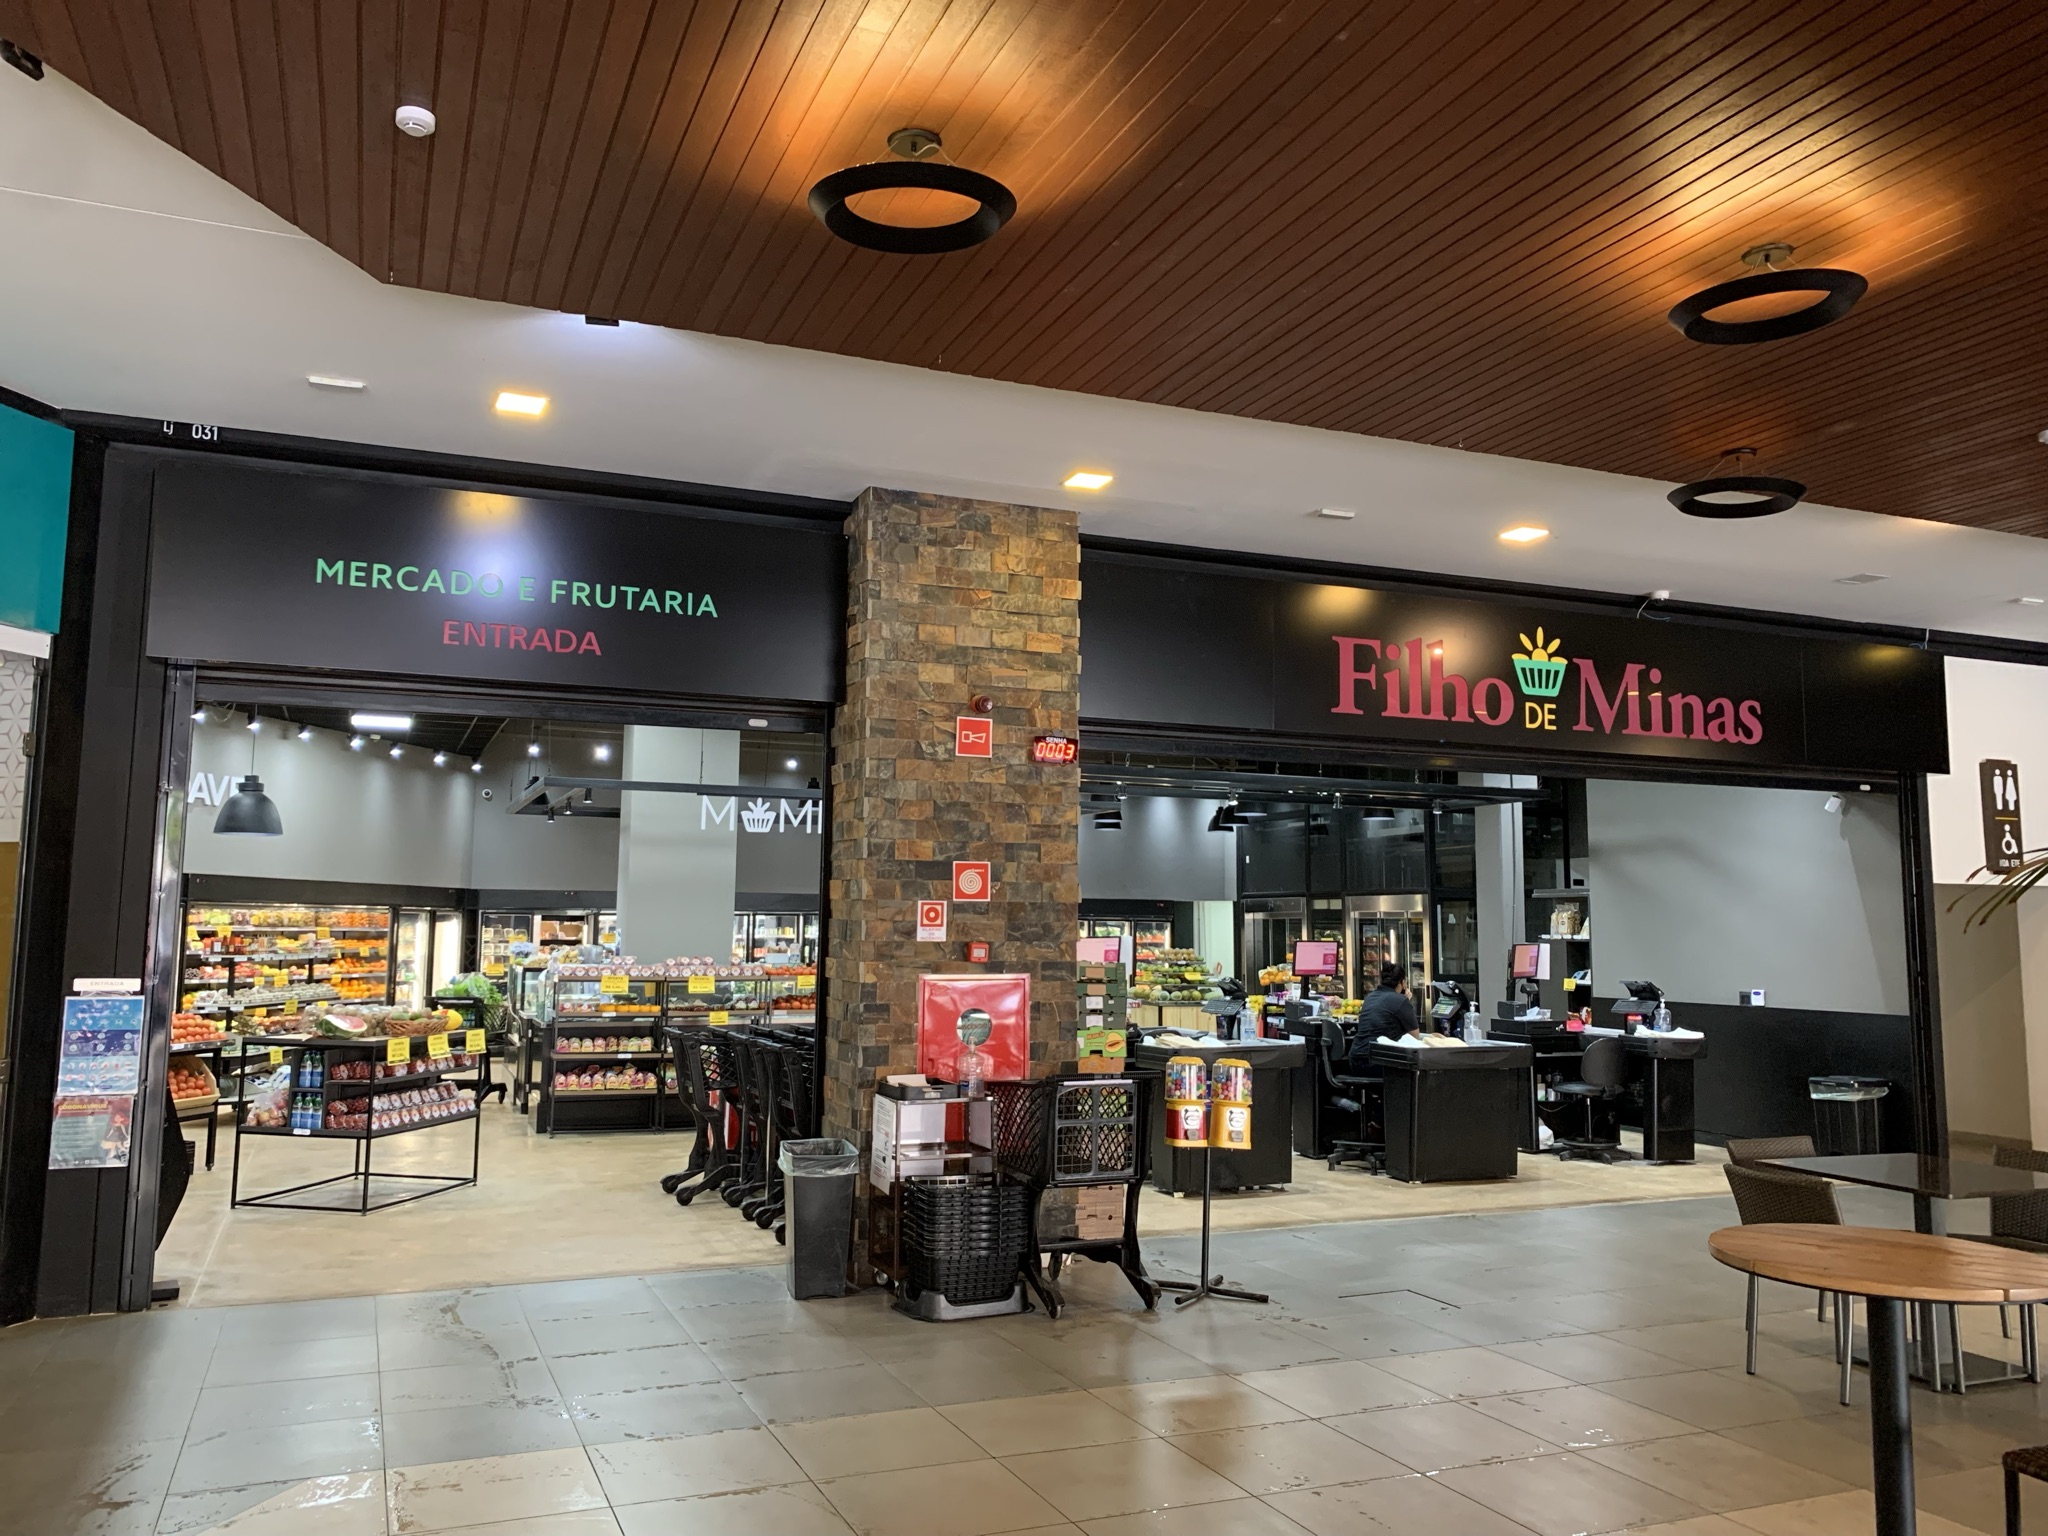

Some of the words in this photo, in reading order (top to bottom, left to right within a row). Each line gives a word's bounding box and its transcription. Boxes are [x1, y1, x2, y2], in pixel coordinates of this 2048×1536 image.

[191, 424, 218, 441] 031
[315, 558, 504, 598] MERCADO
[518, 576, 536, 602] E
[551, 579, 718, 618] FRUTARIA
[443, 620, 602, 656] ENTRADA
[1330, 635, 1515, 726] Filho
[1525, 702, 1557, 731] DE
[1572, 657, 1764, 746] Minas
[1036, 741, 1076, 759] 0003
[1045, 736, 1068, 744] SENHA
